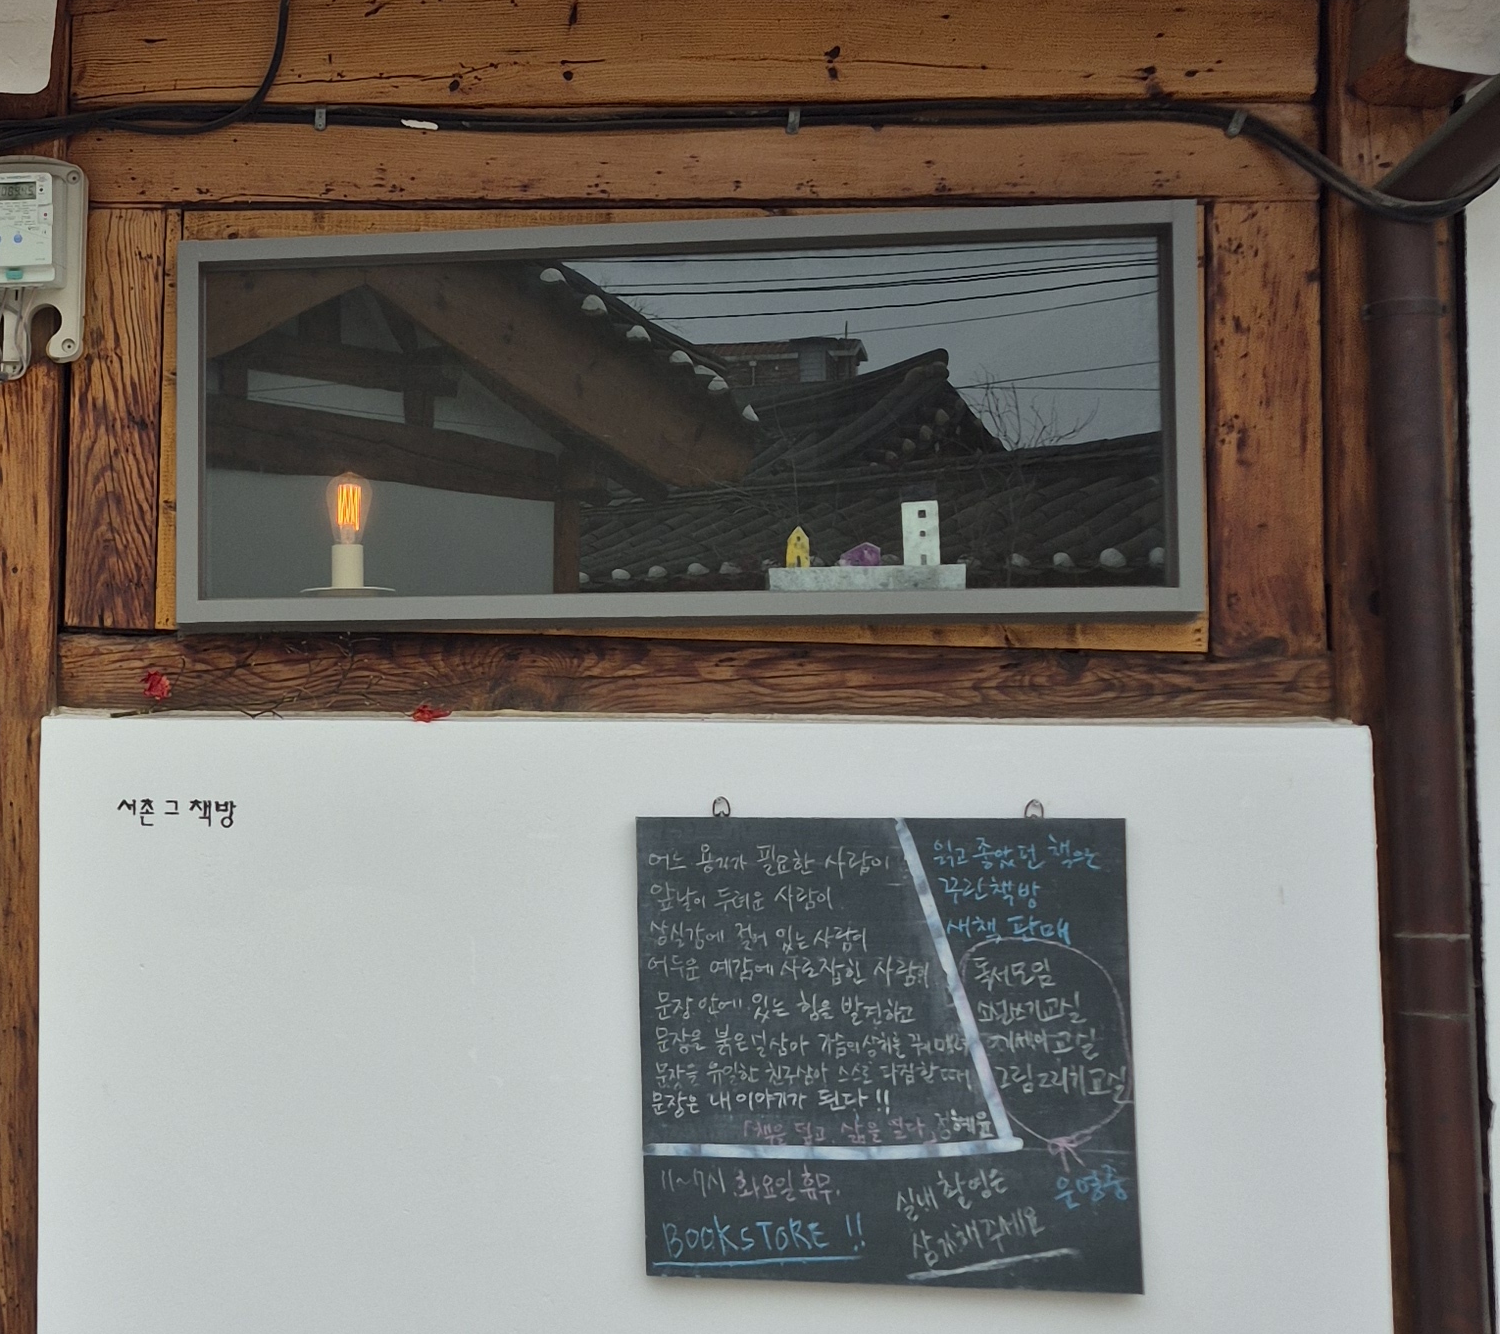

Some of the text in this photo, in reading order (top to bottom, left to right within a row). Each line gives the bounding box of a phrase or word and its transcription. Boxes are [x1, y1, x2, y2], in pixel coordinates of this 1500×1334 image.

[116, 797, 237, 829] 서촌 그 책방
[648, 843, 889, 879] 어느 용기가 필요한 사람이
[933, 838, 969, 868] 읽고
[650, 882, 834, 913] 앞날이 두려운 사람이
[775, 925, 809, 954] 있는
[813, 926, 868, 953] 사람이
[1007, 915, 1071, 946] 판매
[648, 955, 930, 988] 어두운 예감에 사로잡힌 사람이
[972, 956, 1056, 992] 독서모임
[655, 989, 916, 1026] 문장 안에 있는 힘을 발견하고
[656, 1027, 706, 1054] 문장을
[656, 1061, 701, 1090] 문장을
[706, 1061, 760, 1088] 유일한
[838, 1063, 873, 1085] 스스로
[879, 1061, 941, 1086] 다짐할
[652, 1091, 701, 1119] 문장은
[709, 1091, 732, 1112] 내
[736, 1088, 808, 1112] 이야기가
[896, 1168, 1009, 1223] 실내 촬영은
[1054, 1164, 1129, 1211] 운영중
